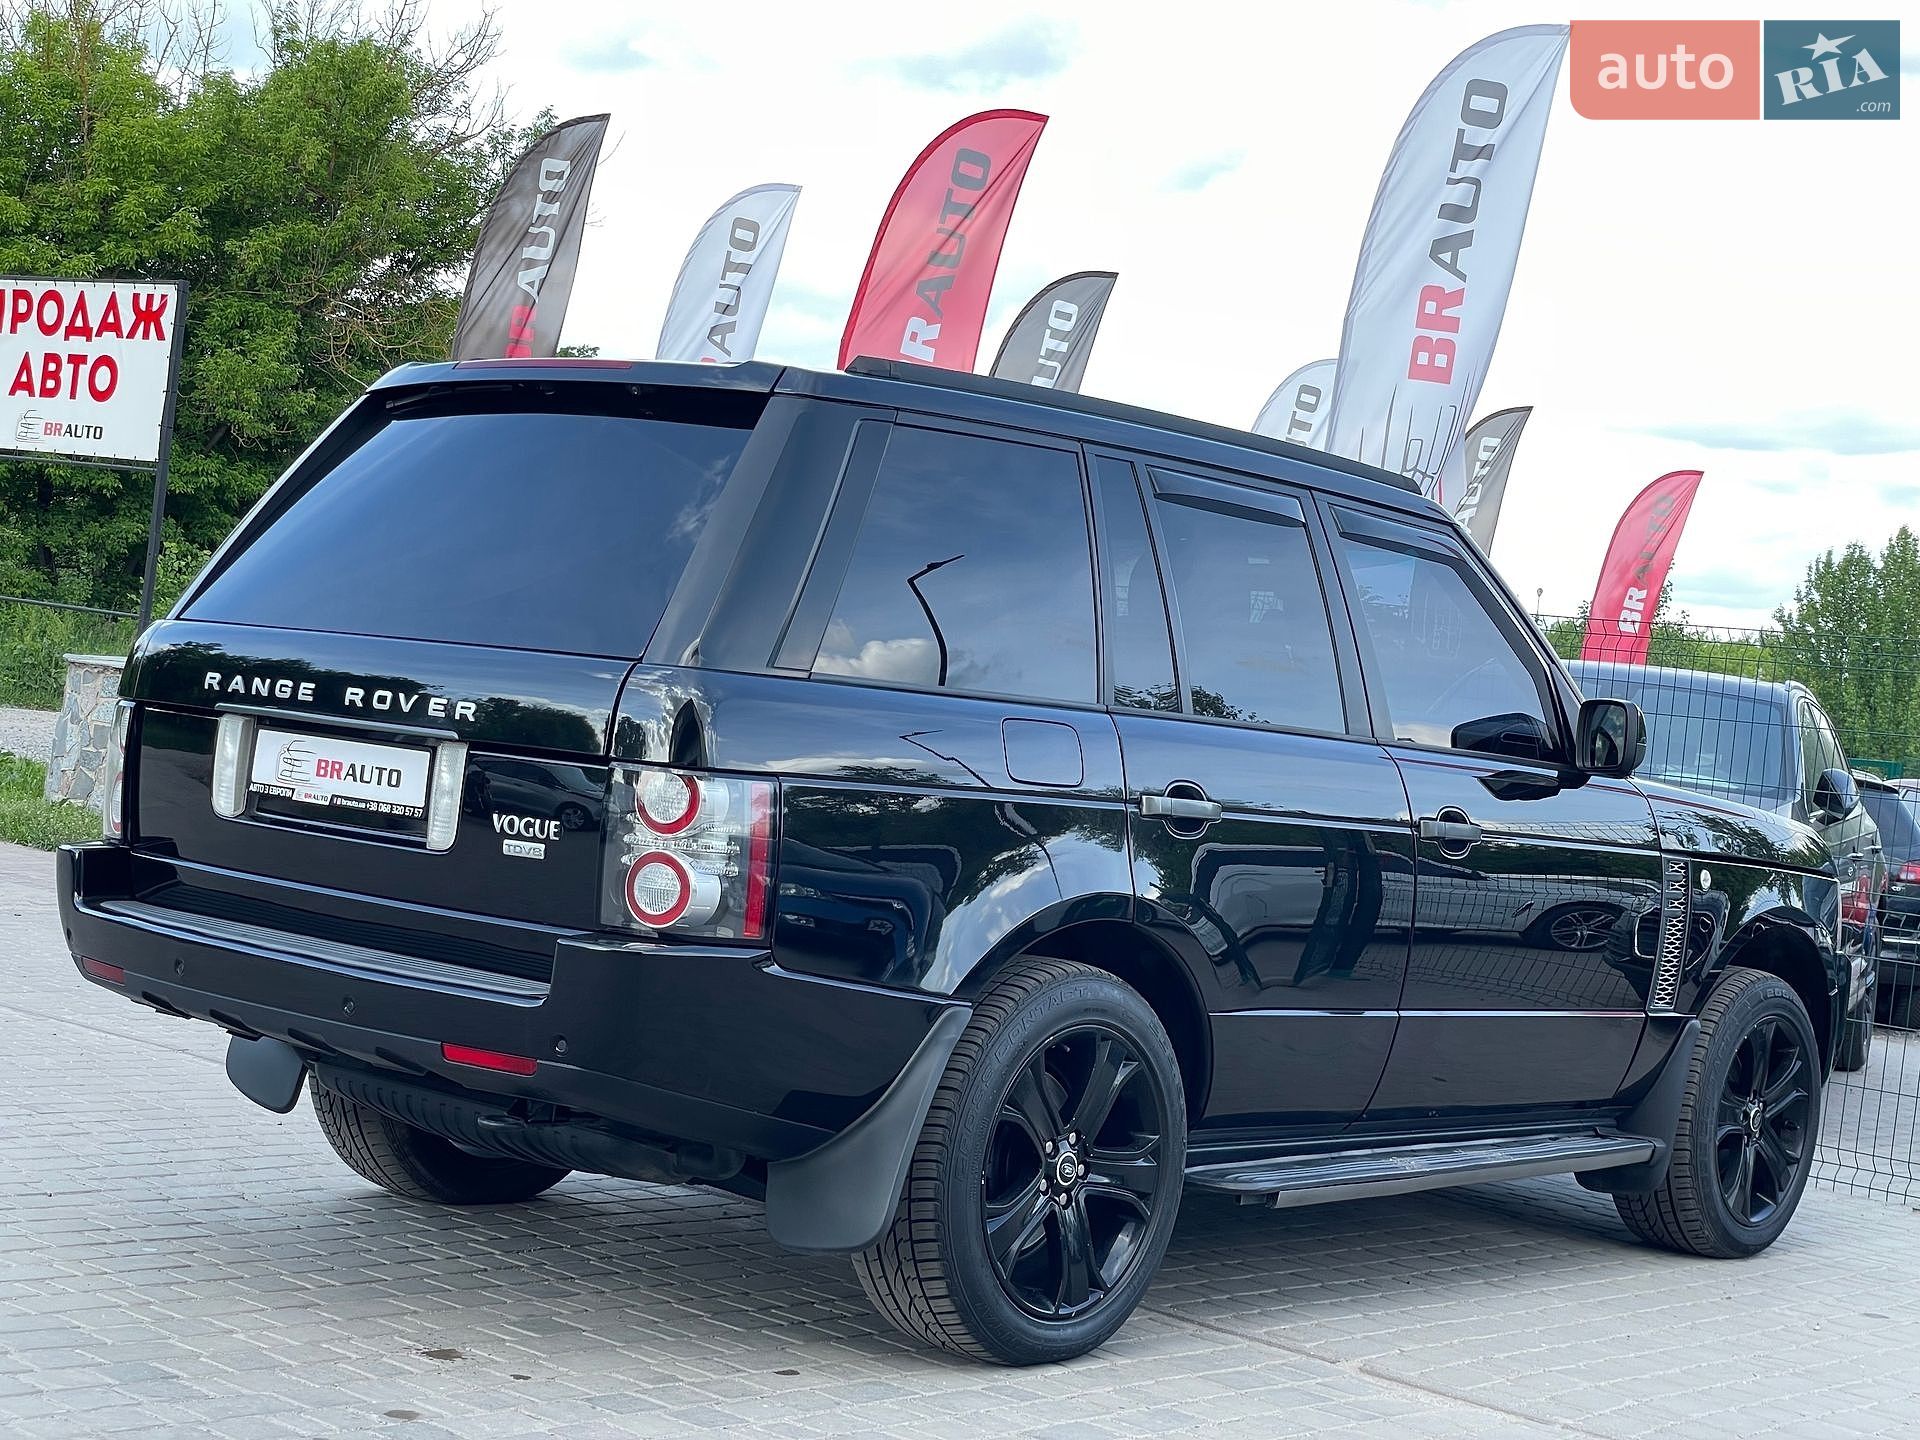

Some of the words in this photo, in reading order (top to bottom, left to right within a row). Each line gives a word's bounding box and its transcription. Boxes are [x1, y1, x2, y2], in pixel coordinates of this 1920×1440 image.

[1408, 78, 1510, 385] BRAUTO
[701, 216, 762, 362] AUTO
[0, 289, 169, 342] РОДАЖ
[8, 351, 119, 403] АВТО
[43, 422, 104, 440] BRAUTO
[204, 672, 316, 701] RANGE
[344, 687, 477, 721] ROVER
[315, 758, 402, 788] BRAUTO
[405, 807, 414, 817] 57
[413, 808, 423, 818] 57
[492, 812, 561, 841] VOGUE
